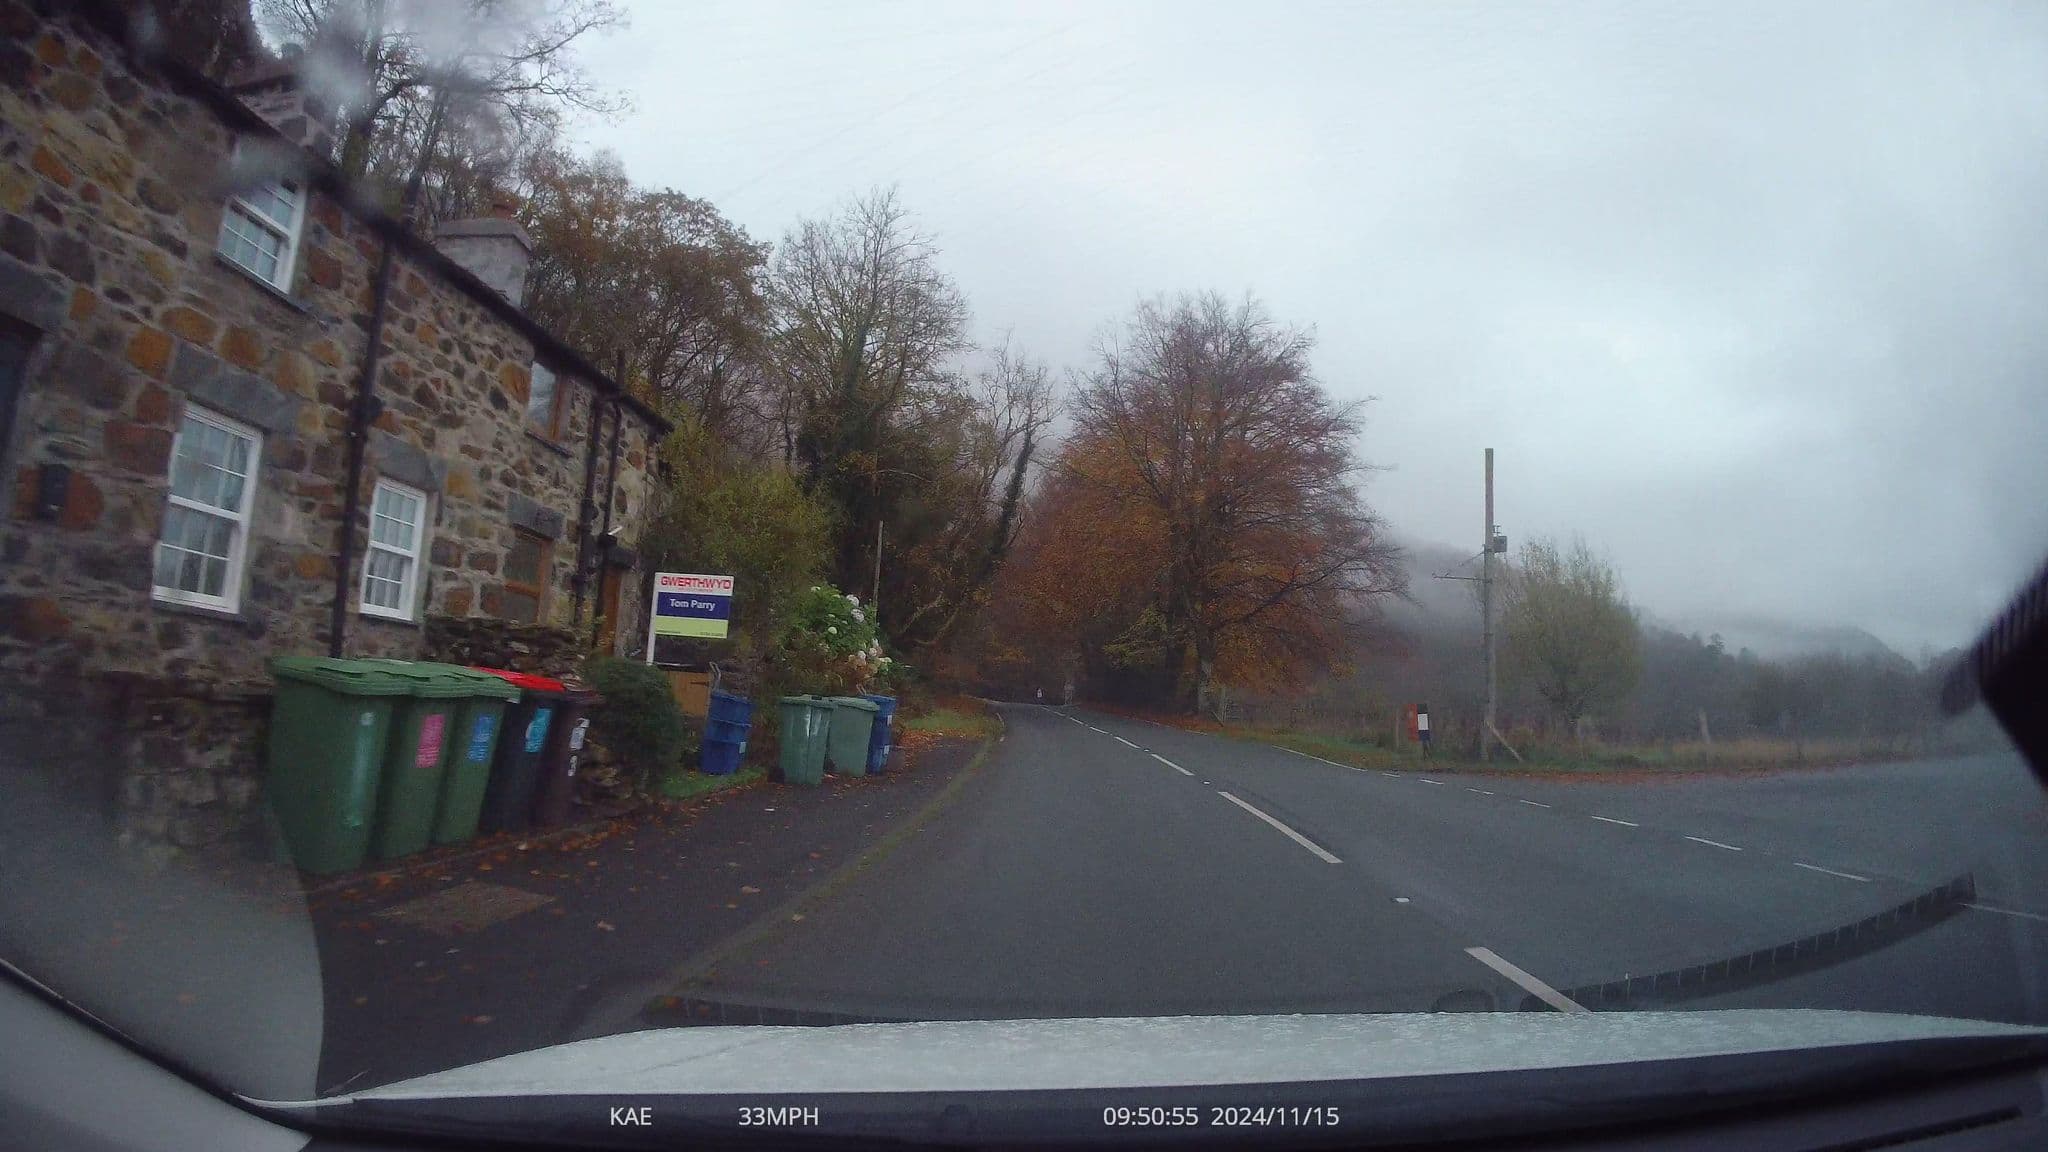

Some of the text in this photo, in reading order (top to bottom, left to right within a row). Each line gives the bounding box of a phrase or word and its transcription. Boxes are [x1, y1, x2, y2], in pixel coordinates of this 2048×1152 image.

[661, 576, 731, 589] GWERTHWYD
[670, 598, 716, 611] Tom Parry
